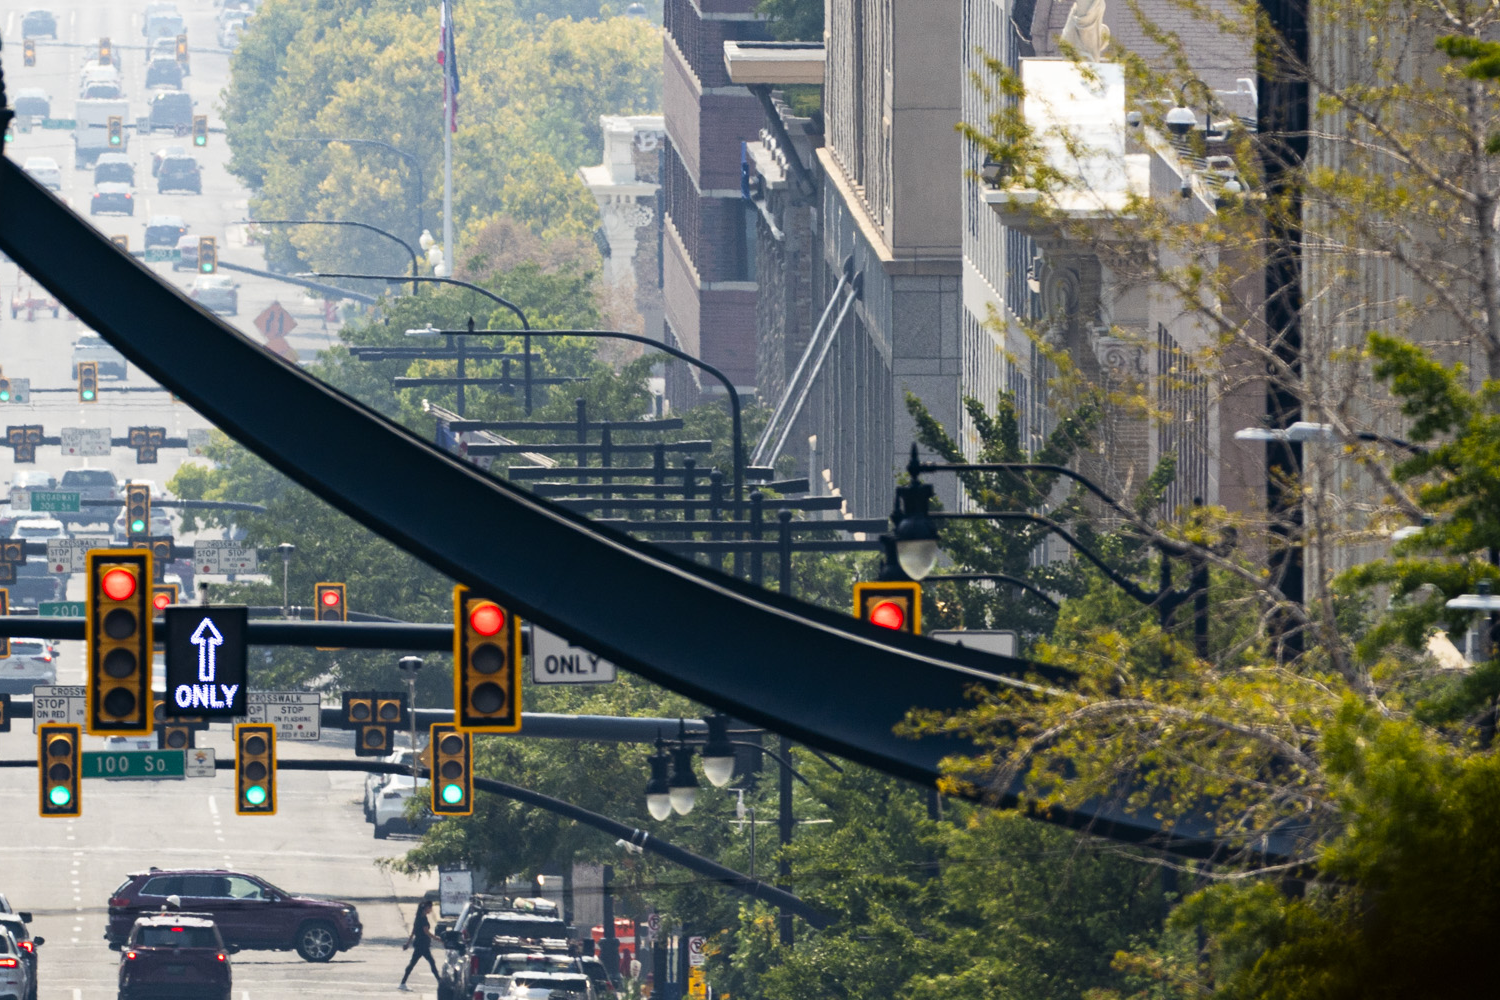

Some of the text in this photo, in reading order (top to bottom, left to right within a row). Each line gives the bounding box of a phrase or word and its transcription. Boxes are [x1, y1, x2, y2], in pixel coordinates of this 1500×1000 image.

[35, 493, 77, 501] BROADWAY
[52, 604, 79, 618] 200
[544, 654, 598, 675] ONLY
[51, 687, 86, 696] CROSSW
[175, 684, 239, 709] ONLY
[248, 694, 302, 703] CROSSWALK
[37, 699, 65, 709] STOP
[37, 710, 65, 718] ON RED
[248, 706, 262, 715] OP
[281, 706, 303, 714] STOP
[97, 756, 129, 772] 100
